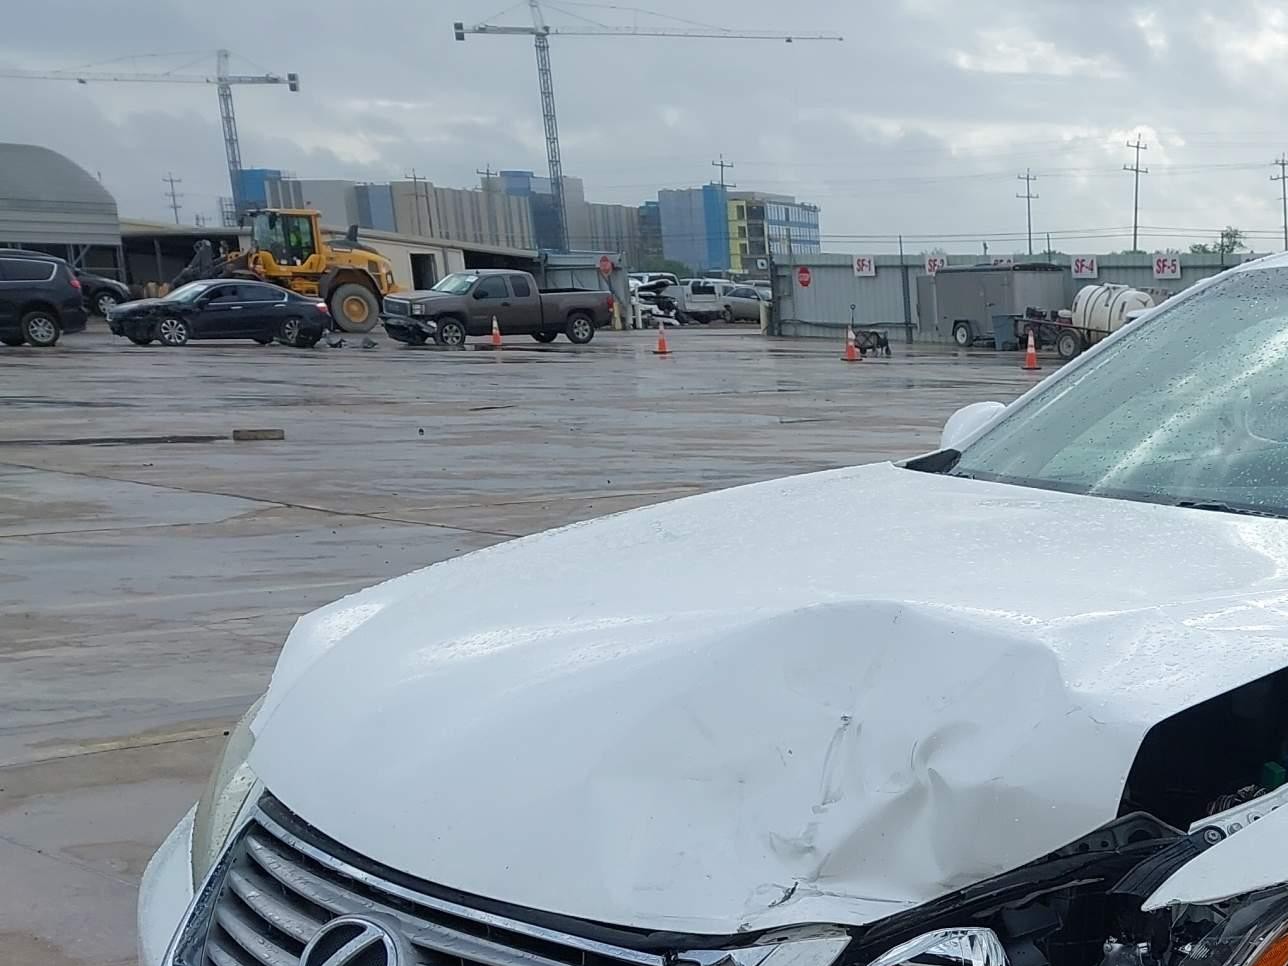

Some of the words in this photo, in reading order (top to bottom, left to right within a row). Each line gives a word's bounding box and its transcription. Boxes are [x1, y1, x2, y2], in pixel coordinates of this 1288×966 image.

[856, 258, 871, 272] SF-1
[1074, 258, 1094, 273] SF-4
[1156, 258, 1177, 274] SF-5
